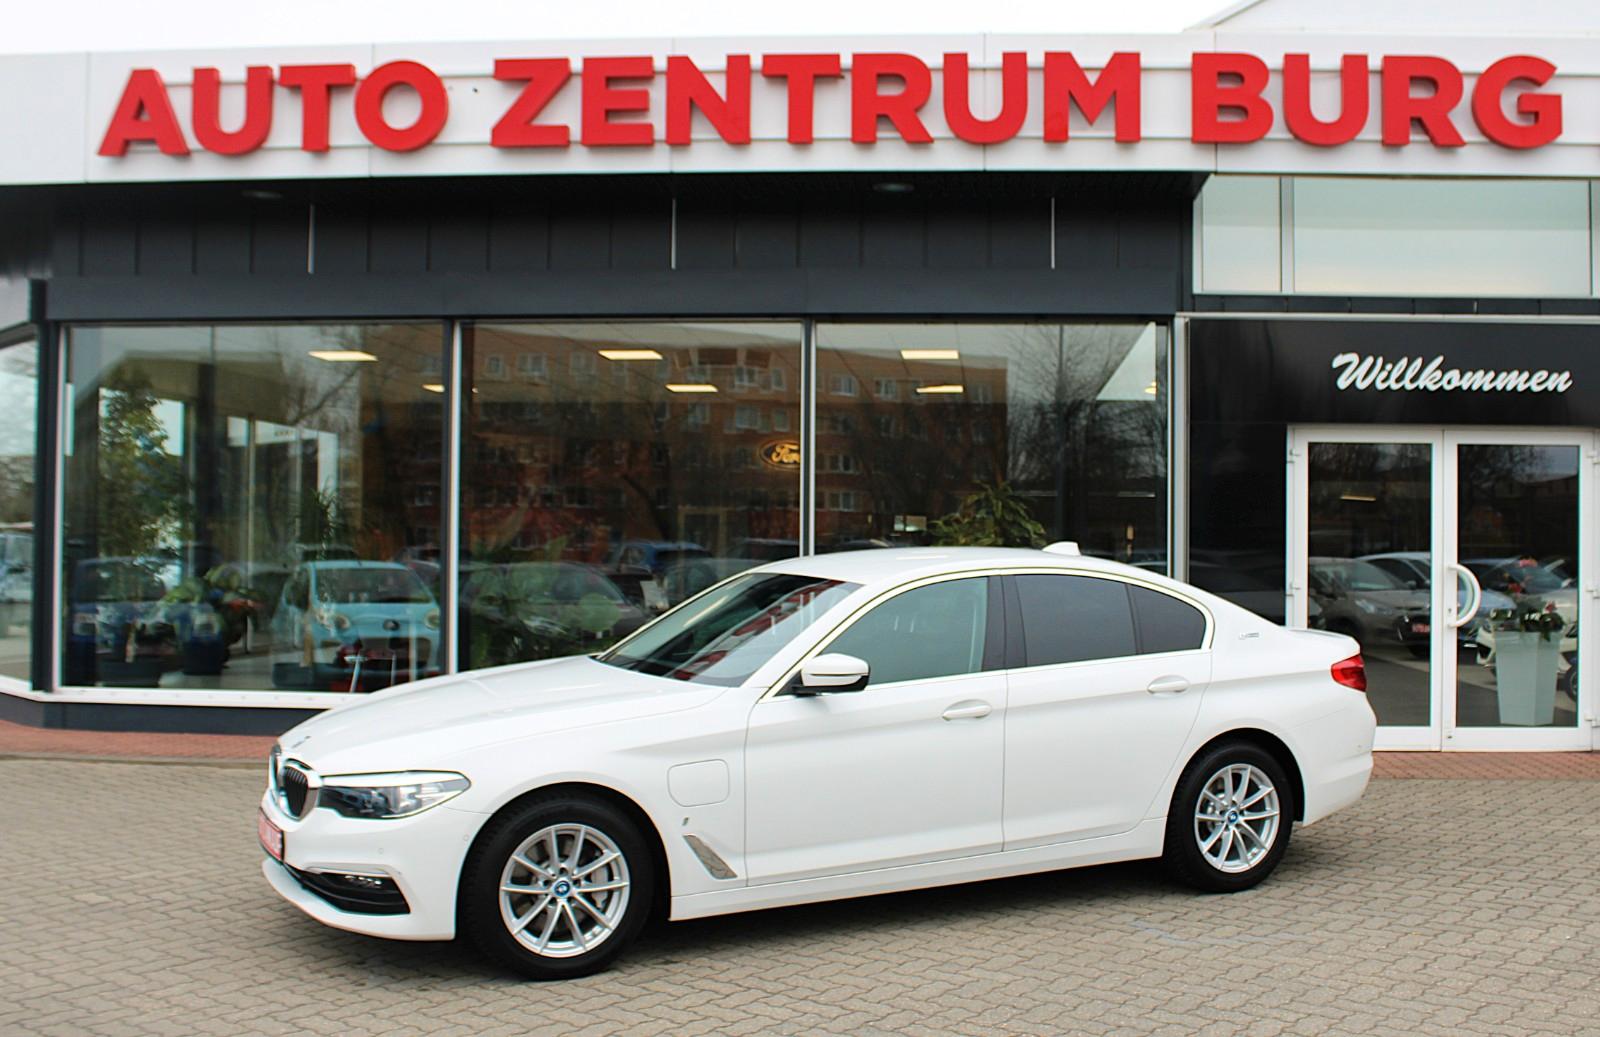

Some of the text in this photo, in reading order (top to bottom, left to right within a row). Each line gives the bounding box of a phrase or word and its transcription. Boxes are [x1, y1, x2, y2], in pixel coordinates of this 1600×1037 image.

[98, 52, 1563, 156] AUTO ZENTRUM BURG
[1331, 352, 1573, 392] Willkommen
